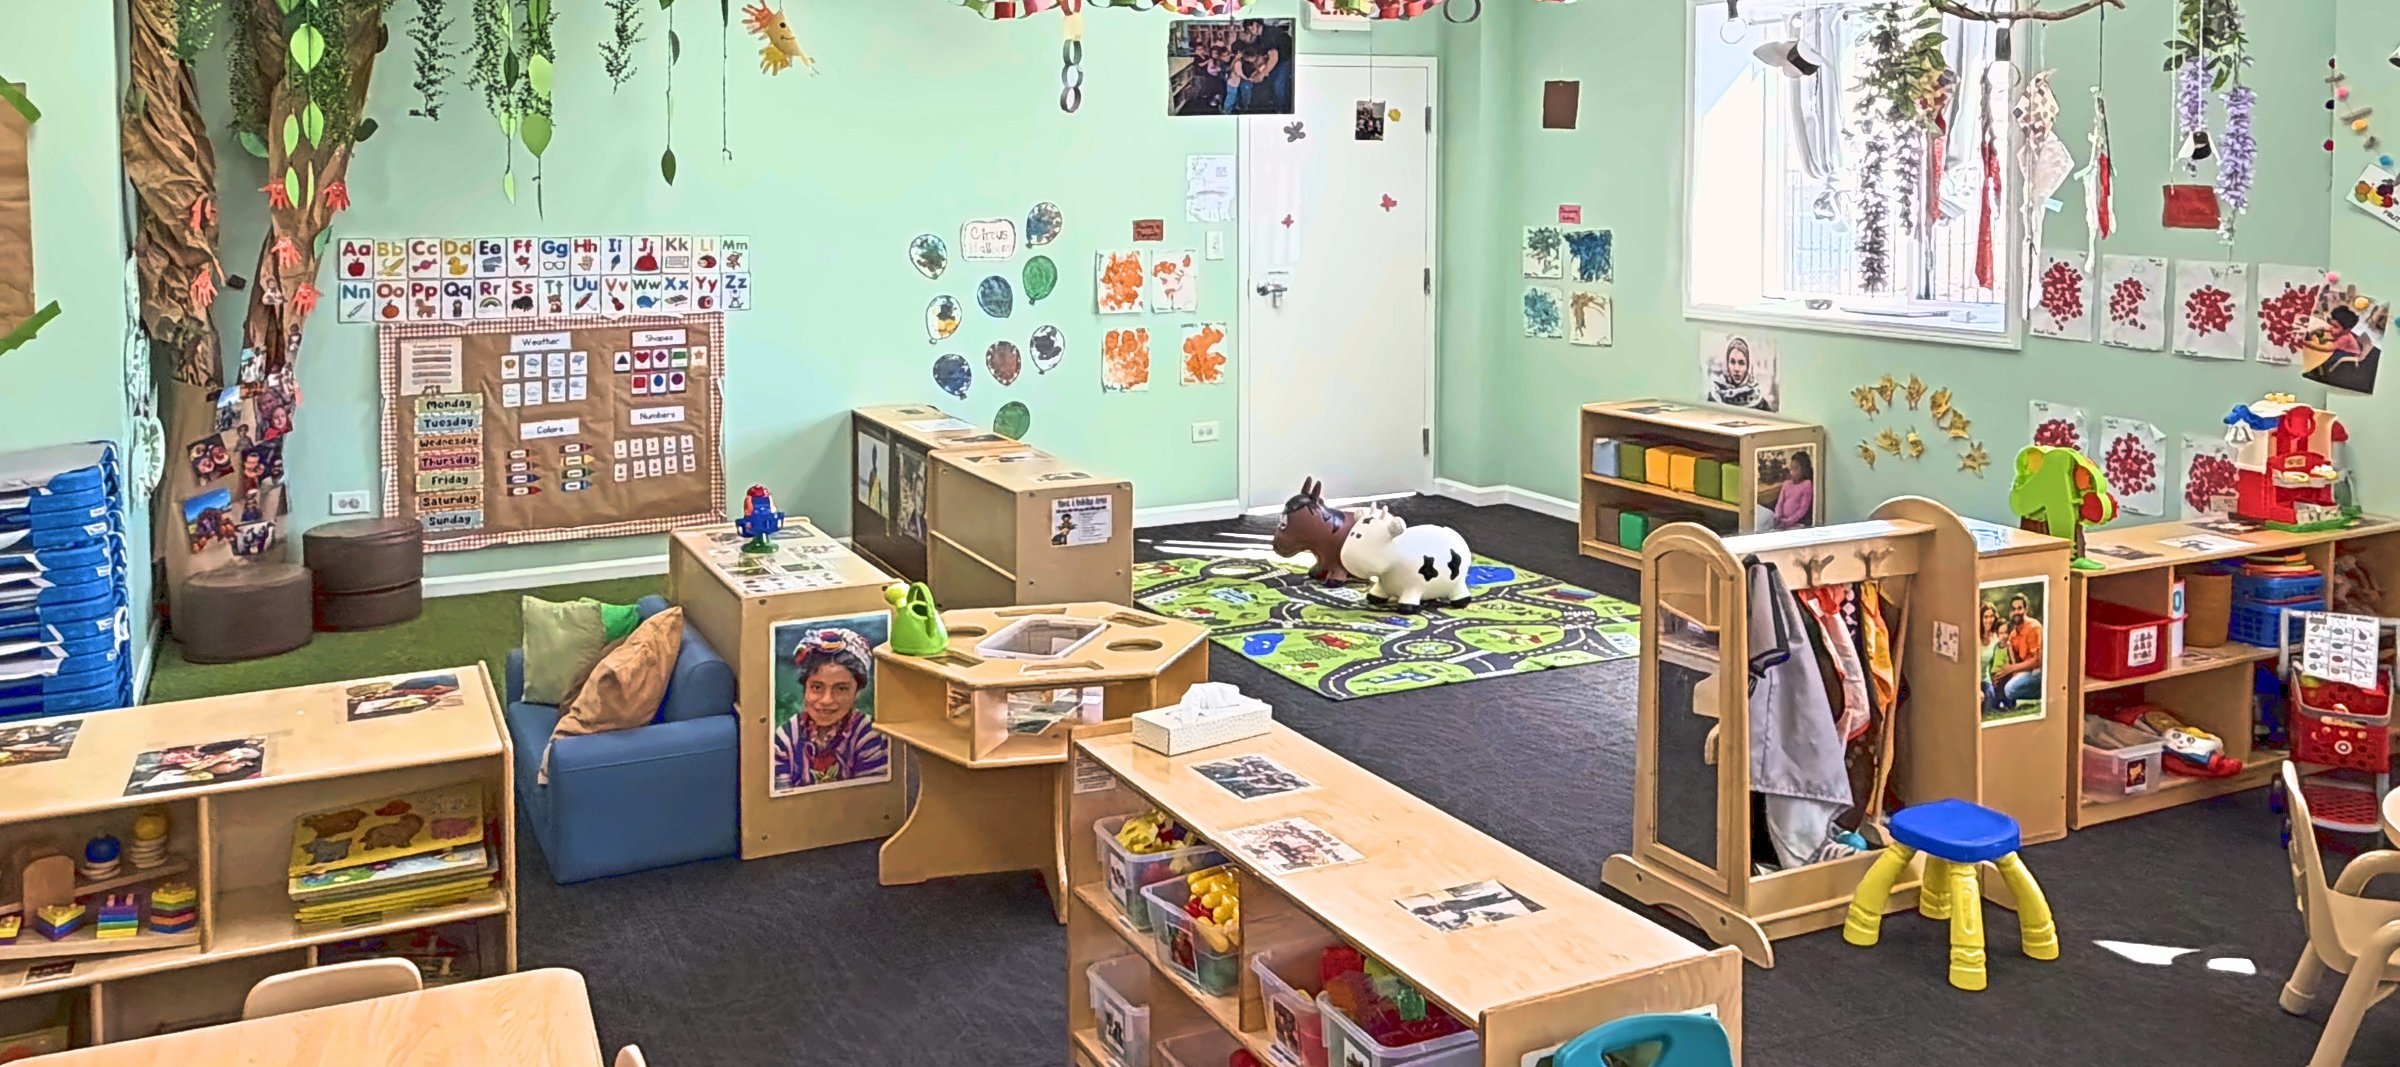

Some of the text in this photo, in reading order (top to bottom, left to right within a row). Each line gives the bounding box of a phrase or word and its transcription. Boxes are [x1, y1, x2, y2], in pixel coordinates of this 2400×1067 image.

[970, 226, 1008, 240] Circus
[342, 237, 748, 258] Aa Bb Cc Dd Ee Ff Gg Hh Ii Jj Kk Ll Mm
[342, 275, 747, 301] Nn Oo Pp Qq Rr Ss Tt Uu Vv Ww Xx Yy Zz
[521, 338, 560, 346] Weather
[645, 334, 674, 343] Shapes
[426, 399, 472, 410] Monday
[640, 411, 676, 420] Numbers
[423, 417, 474, 428] Tuesday
[536, 425, 564, 434] Colors
[420, 436, 478, 447] Wednesday
[422, 455, 476, 467] Thursday
[432, 475, 468, 485] Friday
[422, 495, 477, 506] Saturday
[429, 515, 471, 526] Sunday
